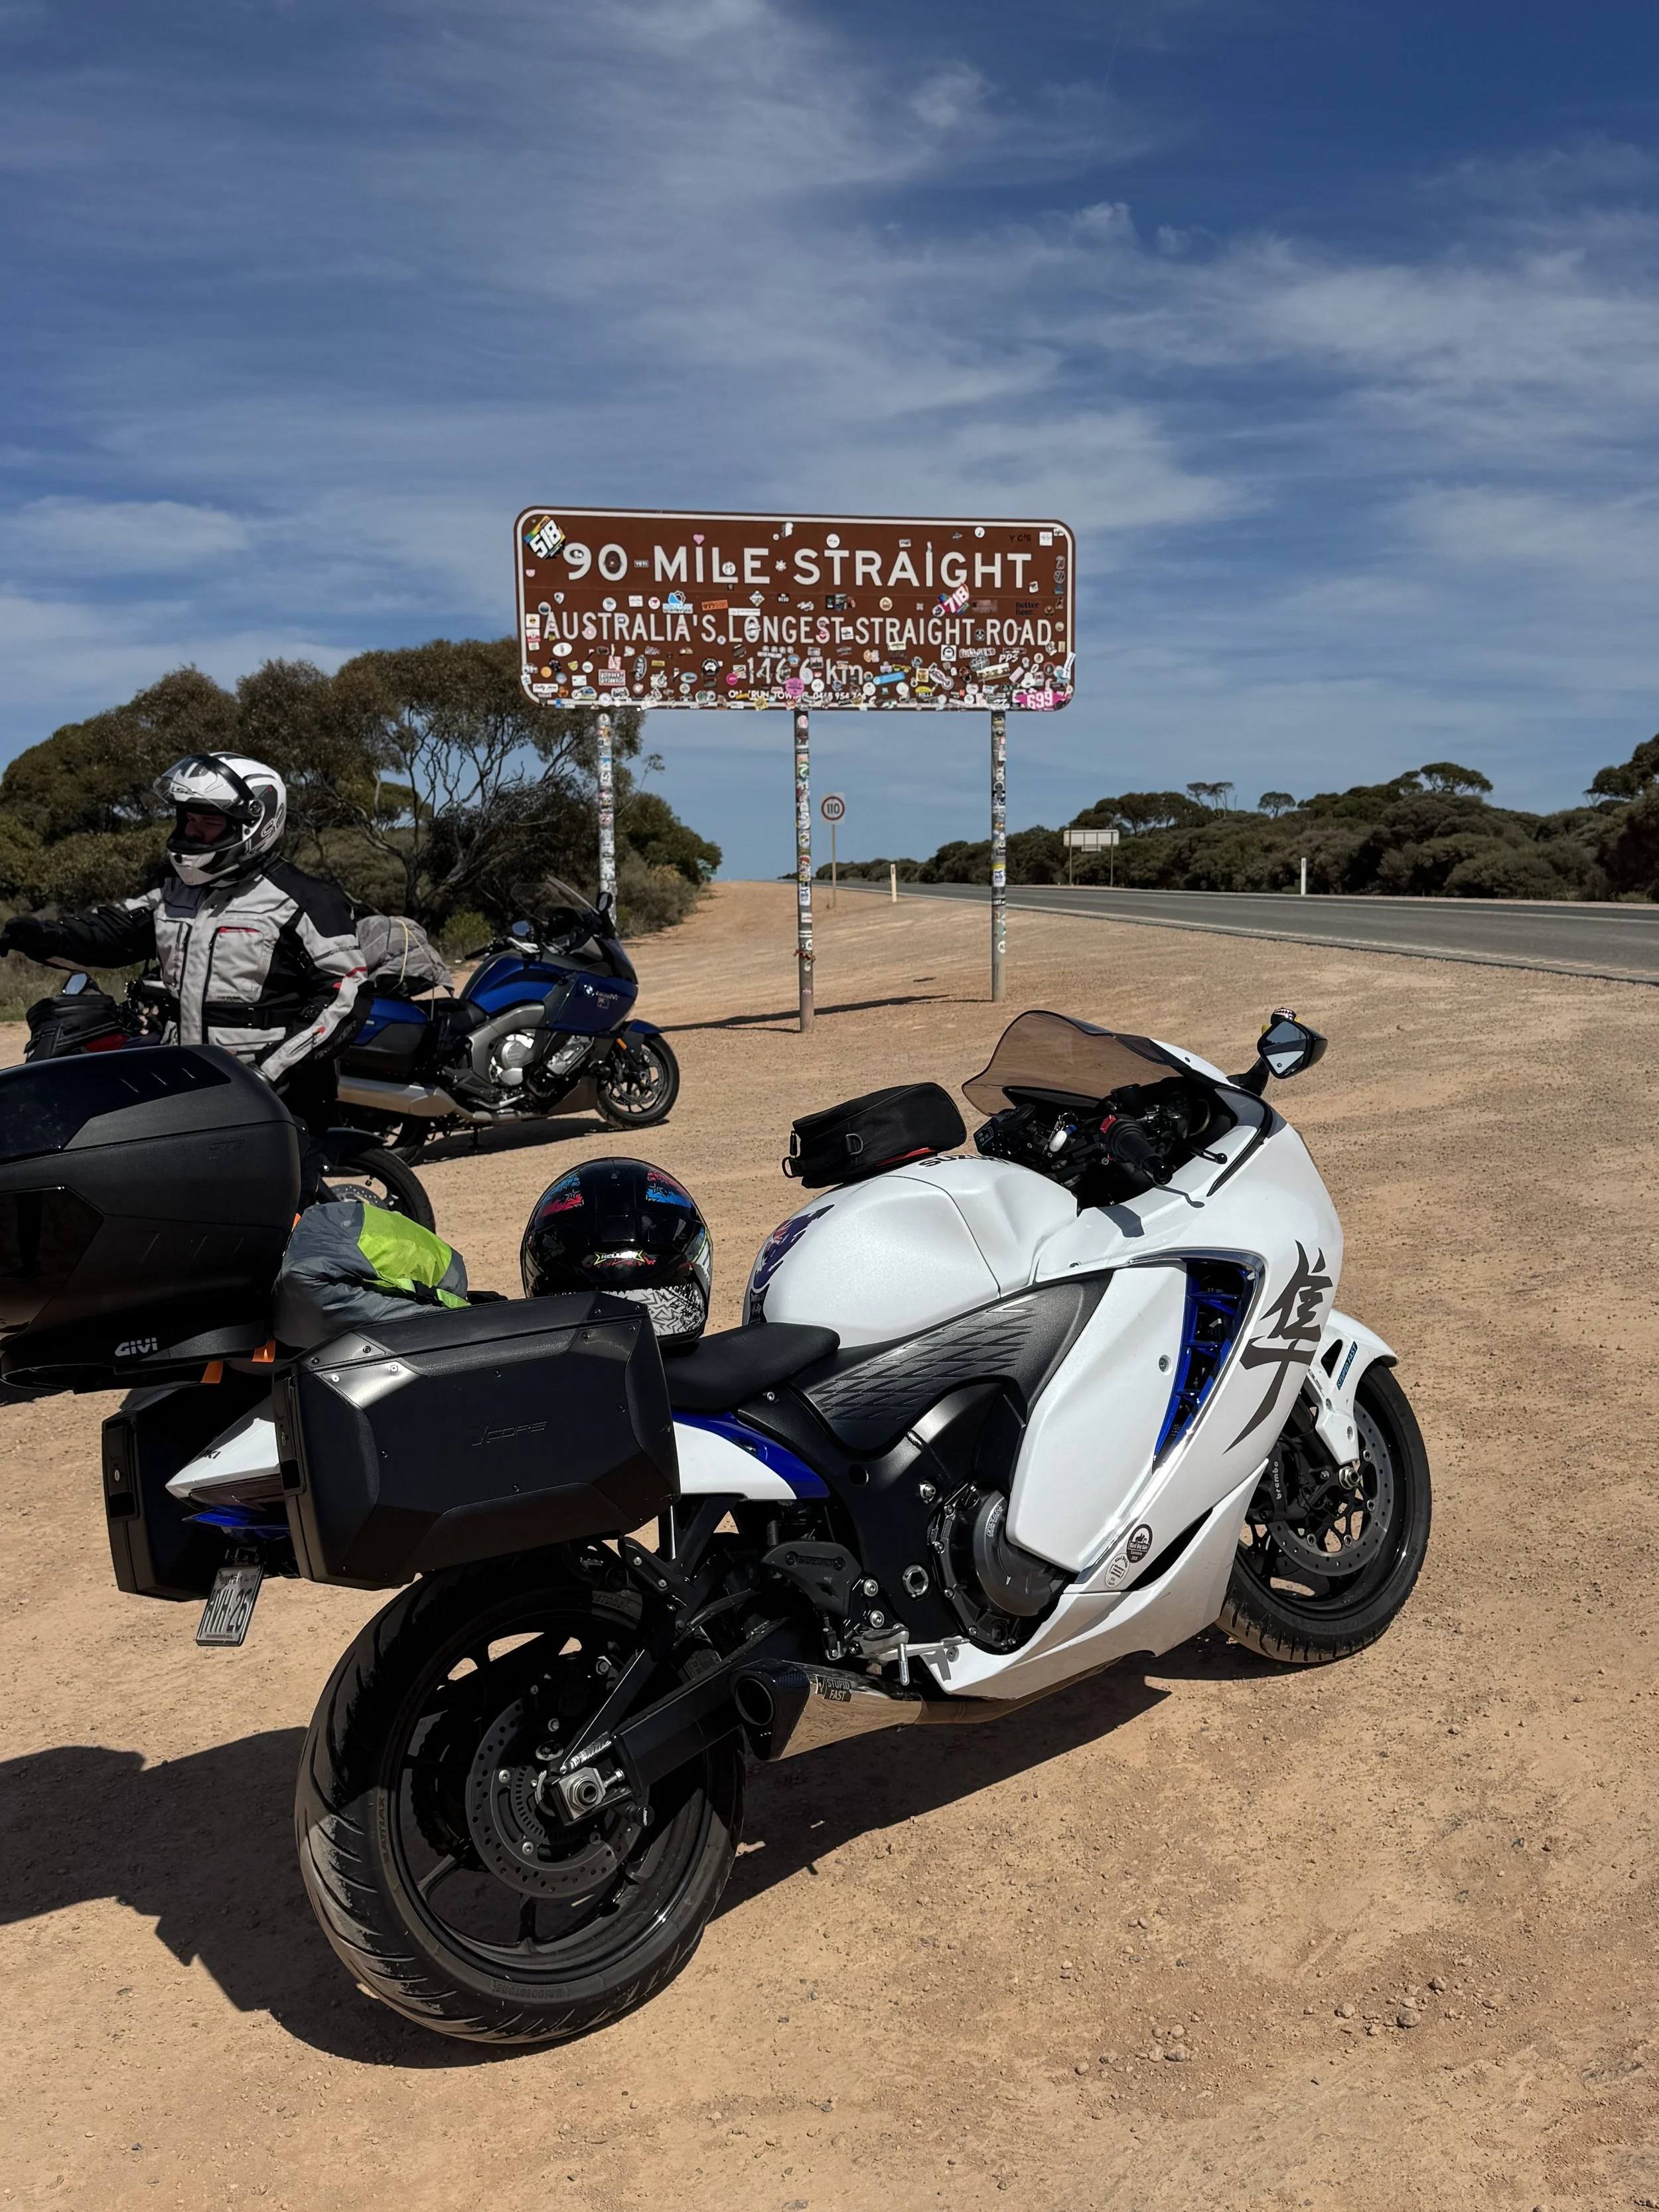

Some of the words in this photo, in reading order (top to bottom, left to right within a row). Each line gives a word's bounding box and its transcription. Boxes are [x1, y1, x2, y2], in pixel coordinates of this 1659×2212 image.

[530, 520, 562, 559] 518
[563, 542, 628, 581] 90
[654, 545, 770, 584] MILE
[794, 548, 1031, 588] STRAIGHT
[543, 612, 716, 642] AUSTRALIA'S
[729, 615, 844, 644] LONGEST
[855, 617, 975, 645] STRAIGHT
[986, 619, 1051, 646] ROAD
[826, 658, 863, 684] km
[1027, 691, 1053, 709] 699
[827, 803, 839, 814] 110
[1222, 1240, 1333, 1455] 隼
[1272, 1461, 1282, 1500] brembo
[827, 1678, 850, 1690] STUPID
[829, 1689, 847, 1701] FAST
